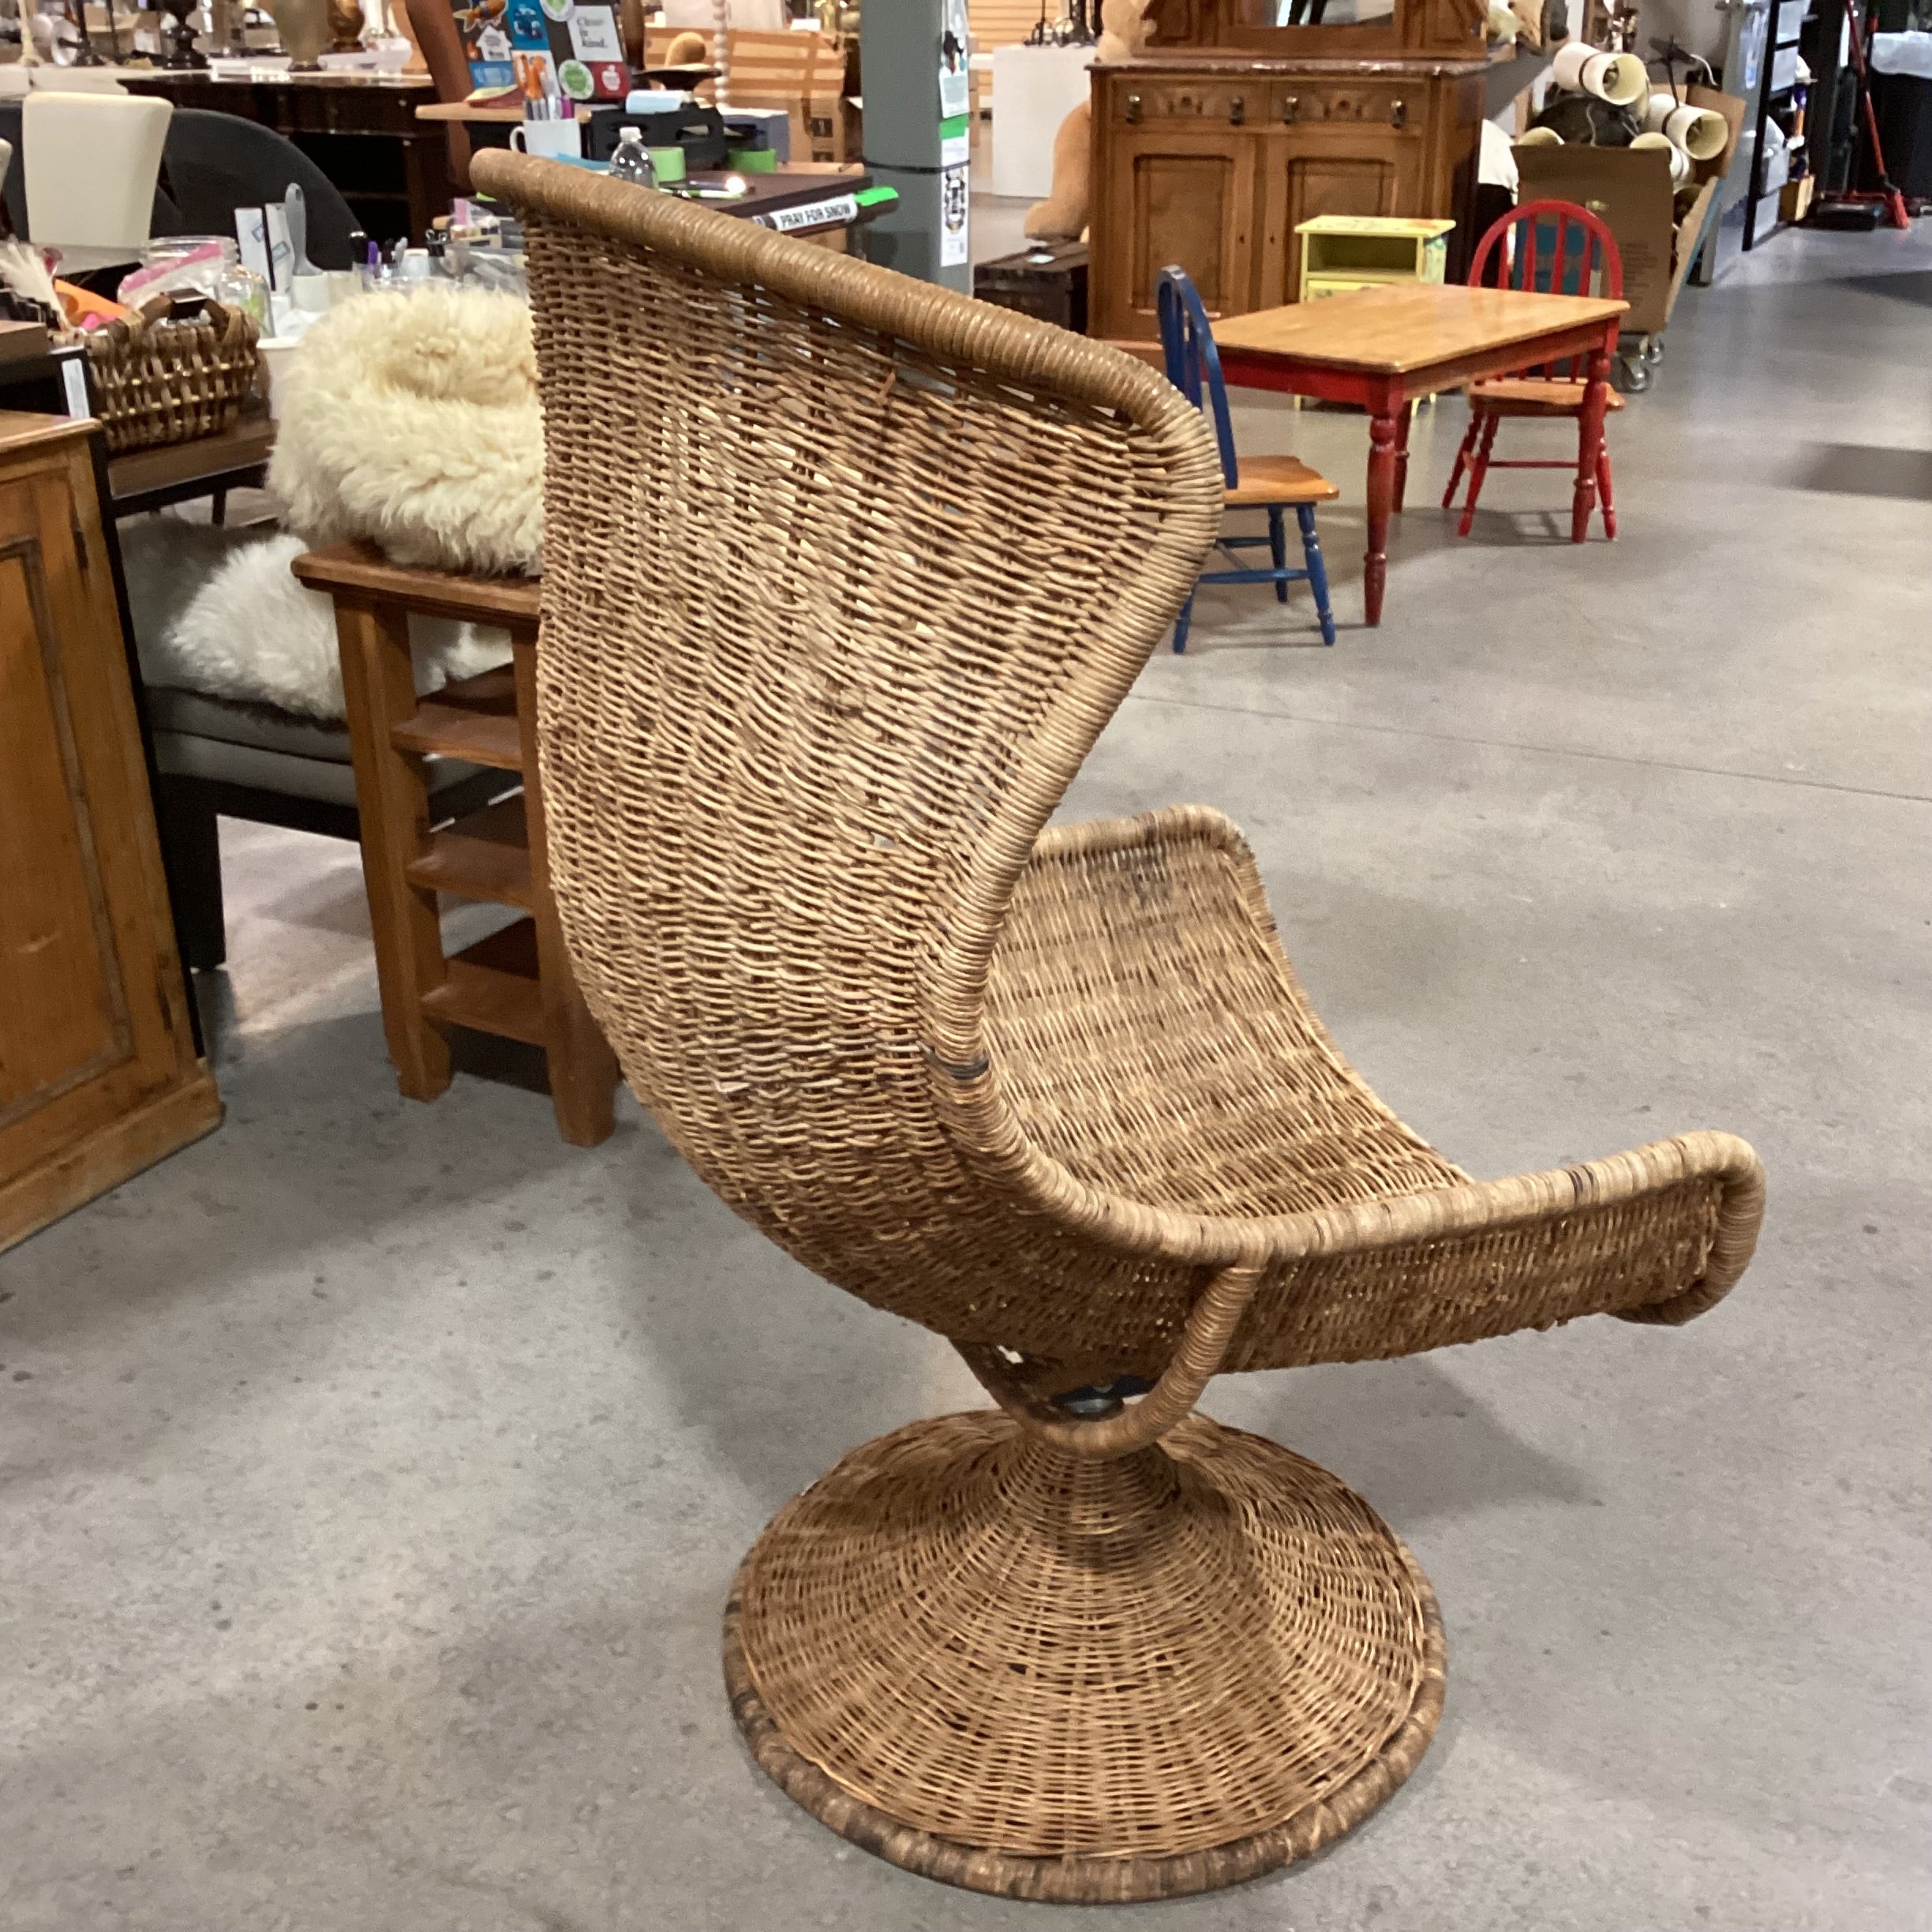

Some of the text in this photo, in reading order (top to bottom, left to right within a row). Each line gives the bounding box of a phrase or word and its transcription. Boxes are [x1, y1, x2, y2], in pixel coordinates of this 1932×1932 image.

[780, 212, 803, 228] PRAY
[804, 208, 824, 223] FOR
[825, 203, 851, 219] SNOW
